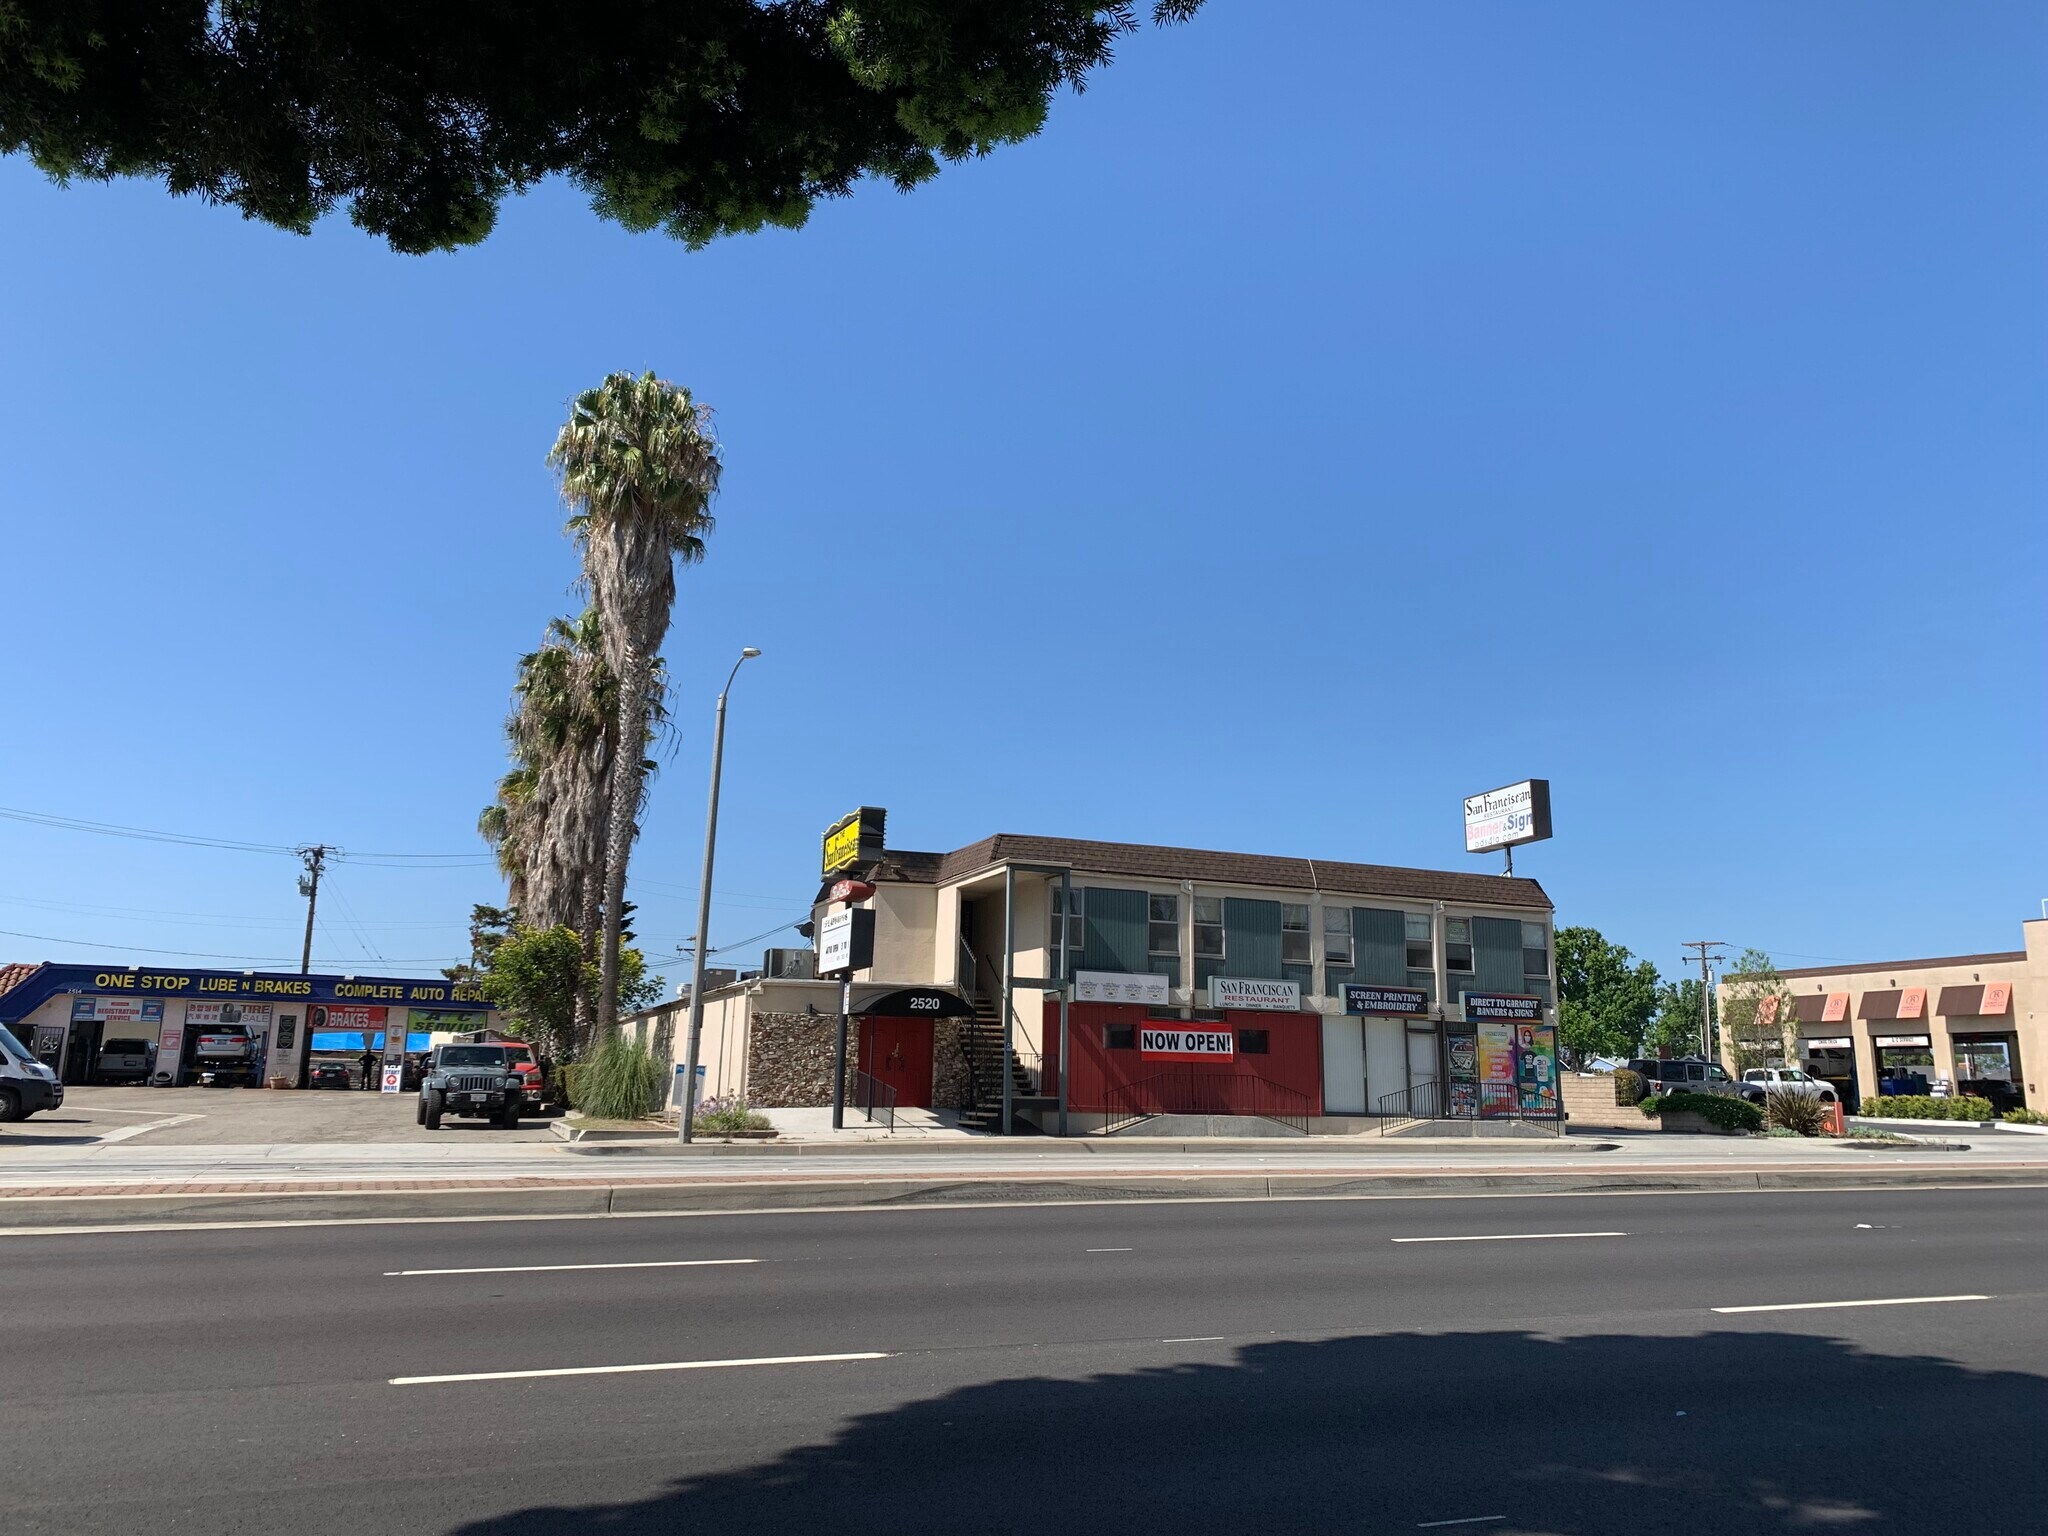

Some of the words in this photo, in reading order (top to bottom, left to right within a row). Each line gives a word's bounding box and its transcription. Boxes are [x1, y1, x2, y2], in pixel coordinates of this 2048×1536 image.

[1465, 799, 1484, 816] San
[1483, 790, 1532, 813] Franciscan
[1483, 806, 1514, 819] RESTAURANT
[1467, 820, 1504, 840] Banner
[1502, 822, 1507, 832] &
[95, 973, 136, 988] ONE
[140, 975, 190, 990] STOP
[199, 978, 238, 992] LUBE
[242, 981, 250, 990] N
[254, 980, 311, 994] BRAKES
[334, 983, 404, 999] COMPLETE
[410, 987, 445, 1000] AUTO
[451, 987, 493, 1003] REPAI
[1220, 980, 1238, 994] SAN
[1238, 981, 1294, 997] FRANCISCAN
[1224, 995, 1290, 1004] RESTAURANT
[1350, 990, 1381, 1000] SCREEN
[1383, 992, 1422, 1003] PRINTING
[1470, 997, 1495, 1007] DIRECT
[1496, 998, 1505, 1008] TO
[1506, 999, 1538, 1009] GARMENT
[240, 1004, 270, 1014] TIRE
[910, 997, 940, 1010] 2520
[1356, 1000, 1363, 1010] &
[1364, 1000, 1418, 1011] EMBROIDERY
[97, 1008, 140, 1016] REGISTRATION
[241, 1014, 269, 1023] SALE
[1476, 1007, 1507, 1017] BANNERS
[1508, 1009, 1514, 1018] &
[1514, 1008, 1534, 1018] SIGNS
[328, 1012, 369, 1028] BRAKES
[413, 1022, 484, 1033] SERVICE
[1143, 1032, 1180, 1050] NOW
[1185, 1033, 1231, 1052] OPEN!
